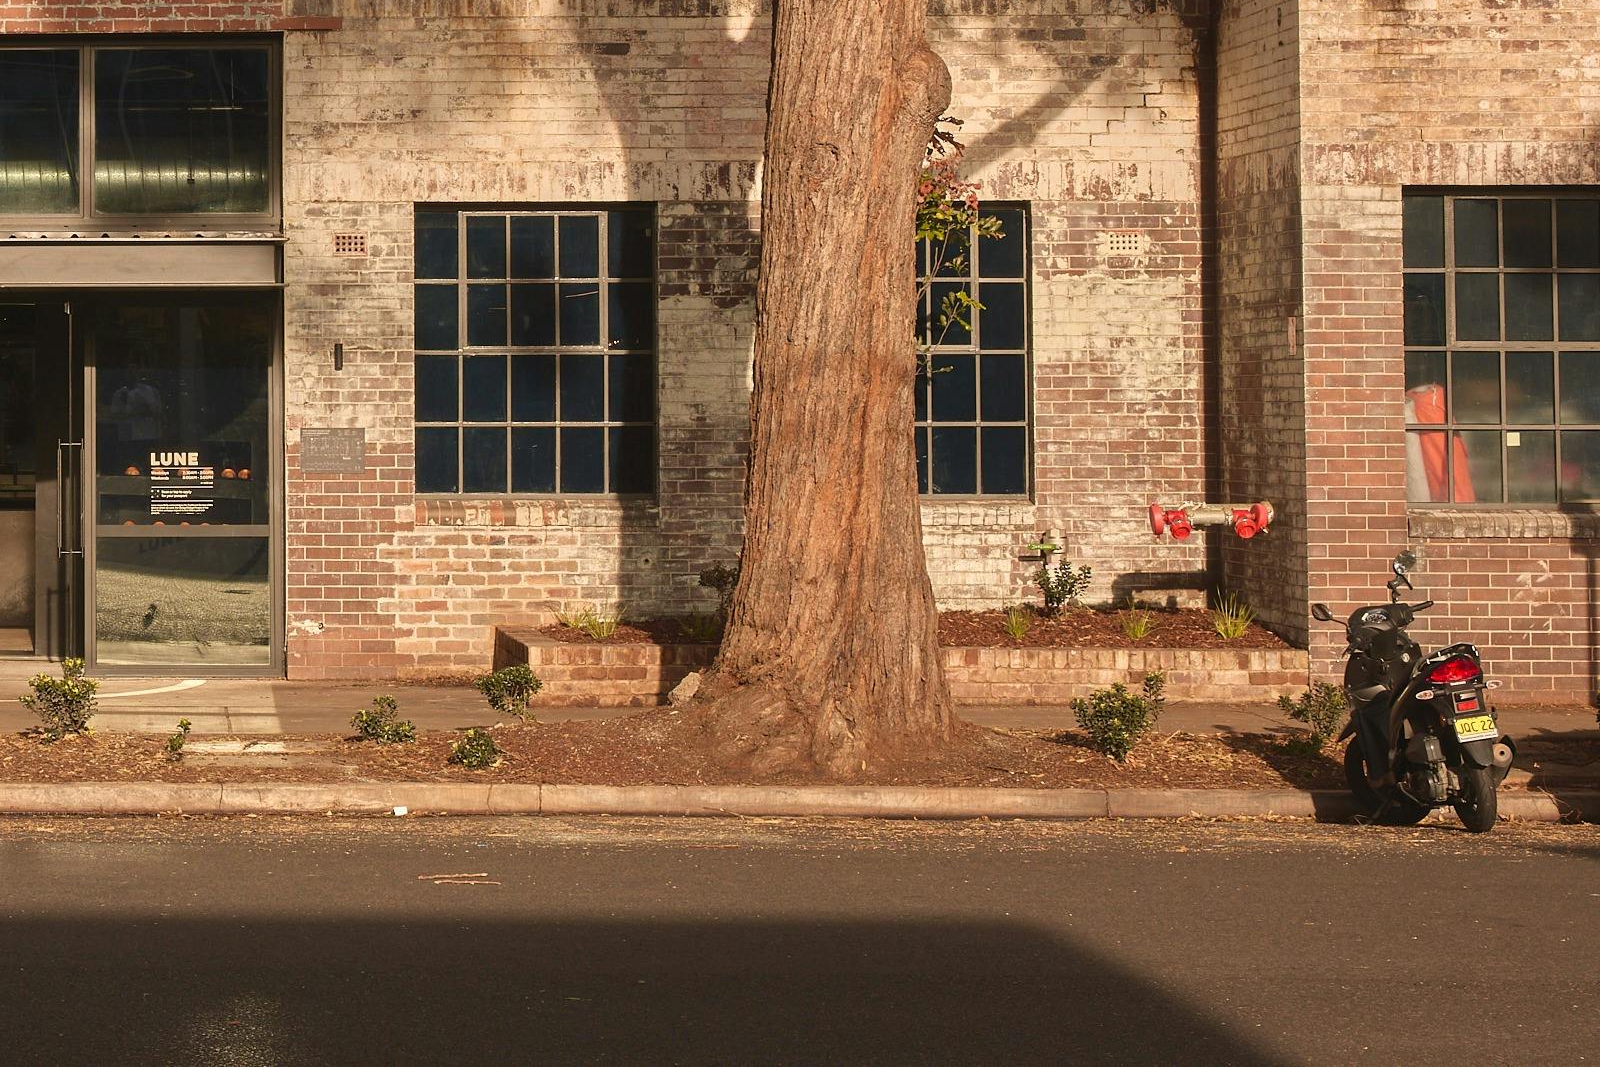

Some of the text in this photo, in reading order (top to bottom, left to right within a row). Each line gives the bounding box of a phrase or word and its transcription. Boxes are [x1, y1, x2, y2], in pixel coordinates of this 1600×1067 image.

[151, 452, 199, 466] LUNE
[1459, 719, 1495, 734] JQC 22
